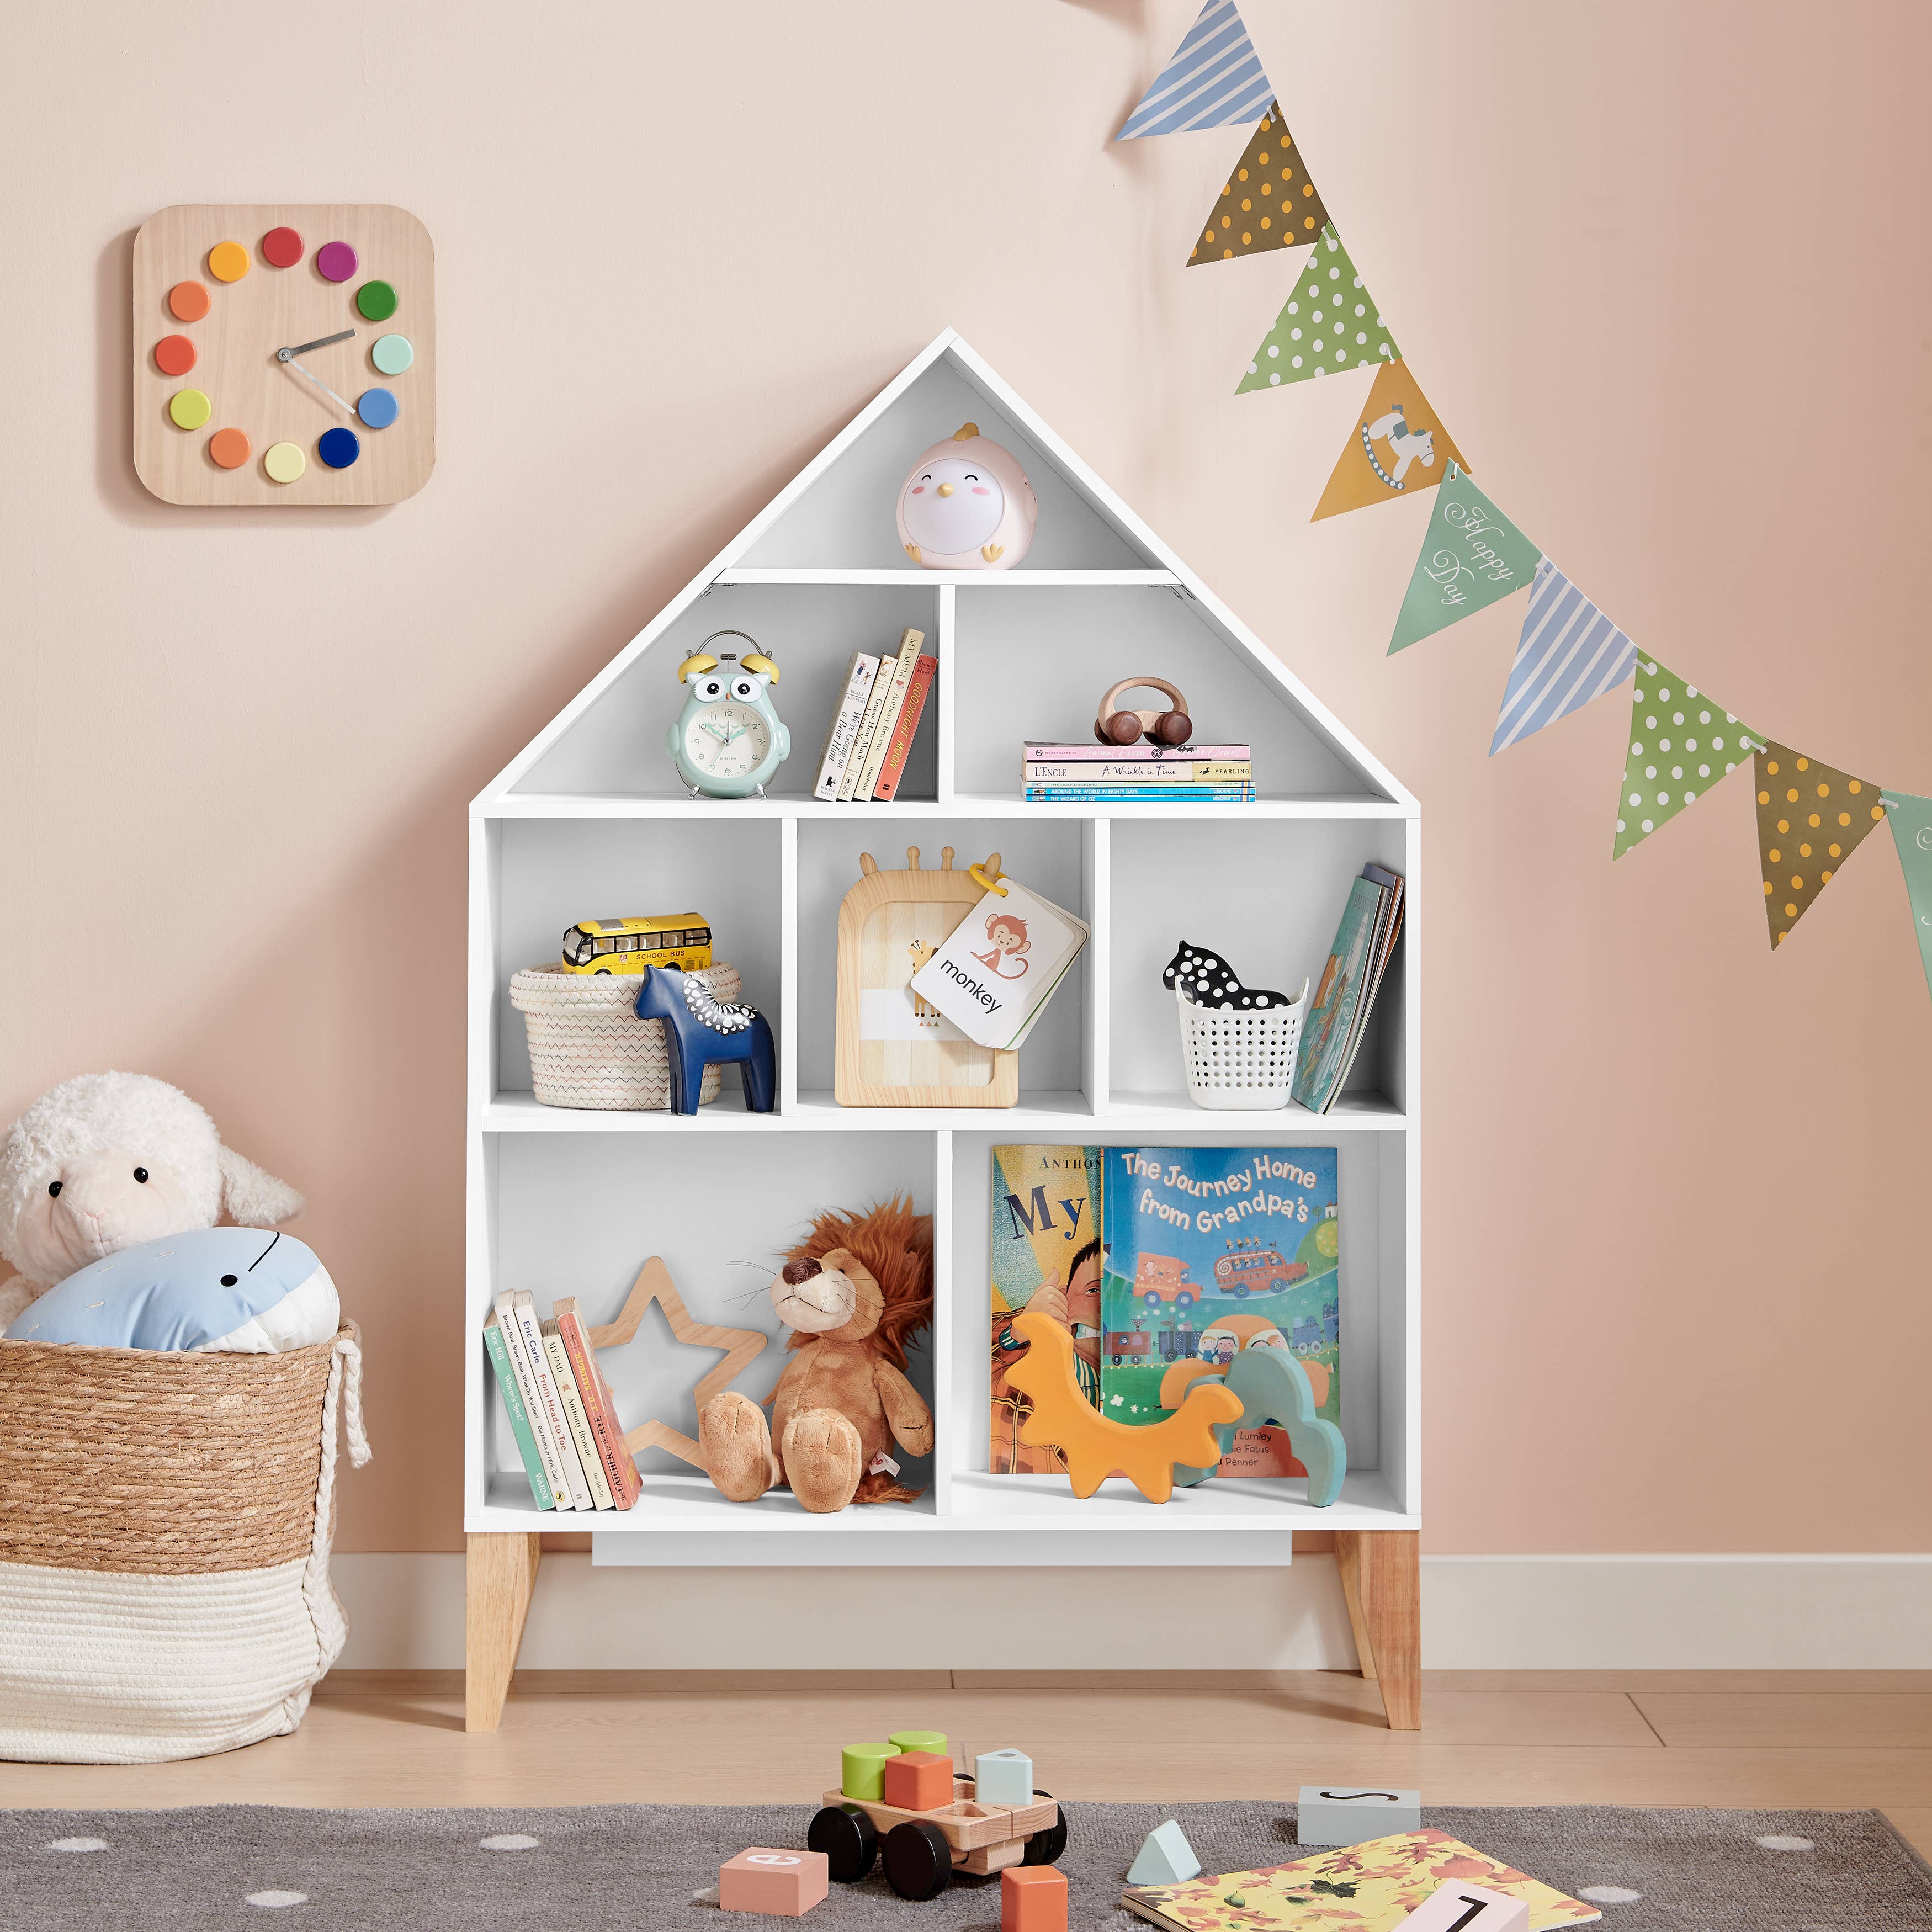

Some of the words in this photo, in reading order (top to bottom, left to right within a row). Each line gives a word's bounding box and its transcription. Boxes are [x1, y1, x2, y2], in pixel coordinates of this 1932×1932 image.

[1444, 502, 1514, 580] Happy
[1424, 550, 1474, 604] Day
[907, 639, 917, 653] MY
[899, 655, 911, 678] MUM
[917, 667, 930, 676] Hurd
[918, 660, 933, 668] Brown
[871, 698, 882, 719] Guess
[884, 692, 900, 724] Anthony
[900, 682, 923, 739] GOODNIGHT
[836, 719, 847, 739] Bear
[849, 712, 861, 732] We're
[860, 713, 870, 730] Love
[864, 721, 875, 739] How
[828, 740, 841, 762] Hunt
[838, 734, 854, 758] Going
[853, 733, 863, 746] You
[857, 740, 868, 760] Much
[875, 725, 889, 752] Browne
[837, 759, 845, 768] on
[889, 740, 905, 771] MOON
[1082, 746, 1116, 759] Animal
[1118, 747, 1144, 758] Farm
[1173, 746, 1205, 758] George
[1208, 746, 1240, 758] Orwell
[862, 766, 874, 792] Doubleday
[1102, 765, 1110, 777] A
[1113, 766, 1144, 775] Wrinkle
[1156, 765, 1176, 776] Time
[940, 959, 1002, 1015] monkey
[1121, 1153, 1161, 1180] The
[1164, 1166, 1252, 1197] Journey
[1254, 1155, 1317, 1189] Home
[1004, 1185, 1086, 1240] My
[1140, 1188, 1191, 1230] from
[1196, 1190, 1309, 1233] Grandpa's
[490, 1331, 499, 1346] Eric
[495, 1347, 505, 1360] Hill
[523, 1320, 533, 1338] Eric
[529, 1340, 540, 1363] Carle
[548, 1342, 558, 1353] MY
[553, 1356, 564, 1373] DAD
[575, 1352, 591, 1391] SALINGER
[505, 1374, 517, 1402] Where's
[513, 1402, 524, 1421] Spot?
[539, 1374, 550, 1398] From
[547, 1399, 560, 1423] Head
[555, 1424, 561, 1434] to
[568, 1399, 582, 1429] Anthony
[578, 1430, 591, 1458] Browne
[594, 1415, 606, 1435] RYE
[1240, 1431, 1271, 1442] Lumley
[606, 1451, 623, 1492] CATCHER
[535, 1472, 549, 1501] WARNE
[593, 1472, 604, 1498] Doubleday
